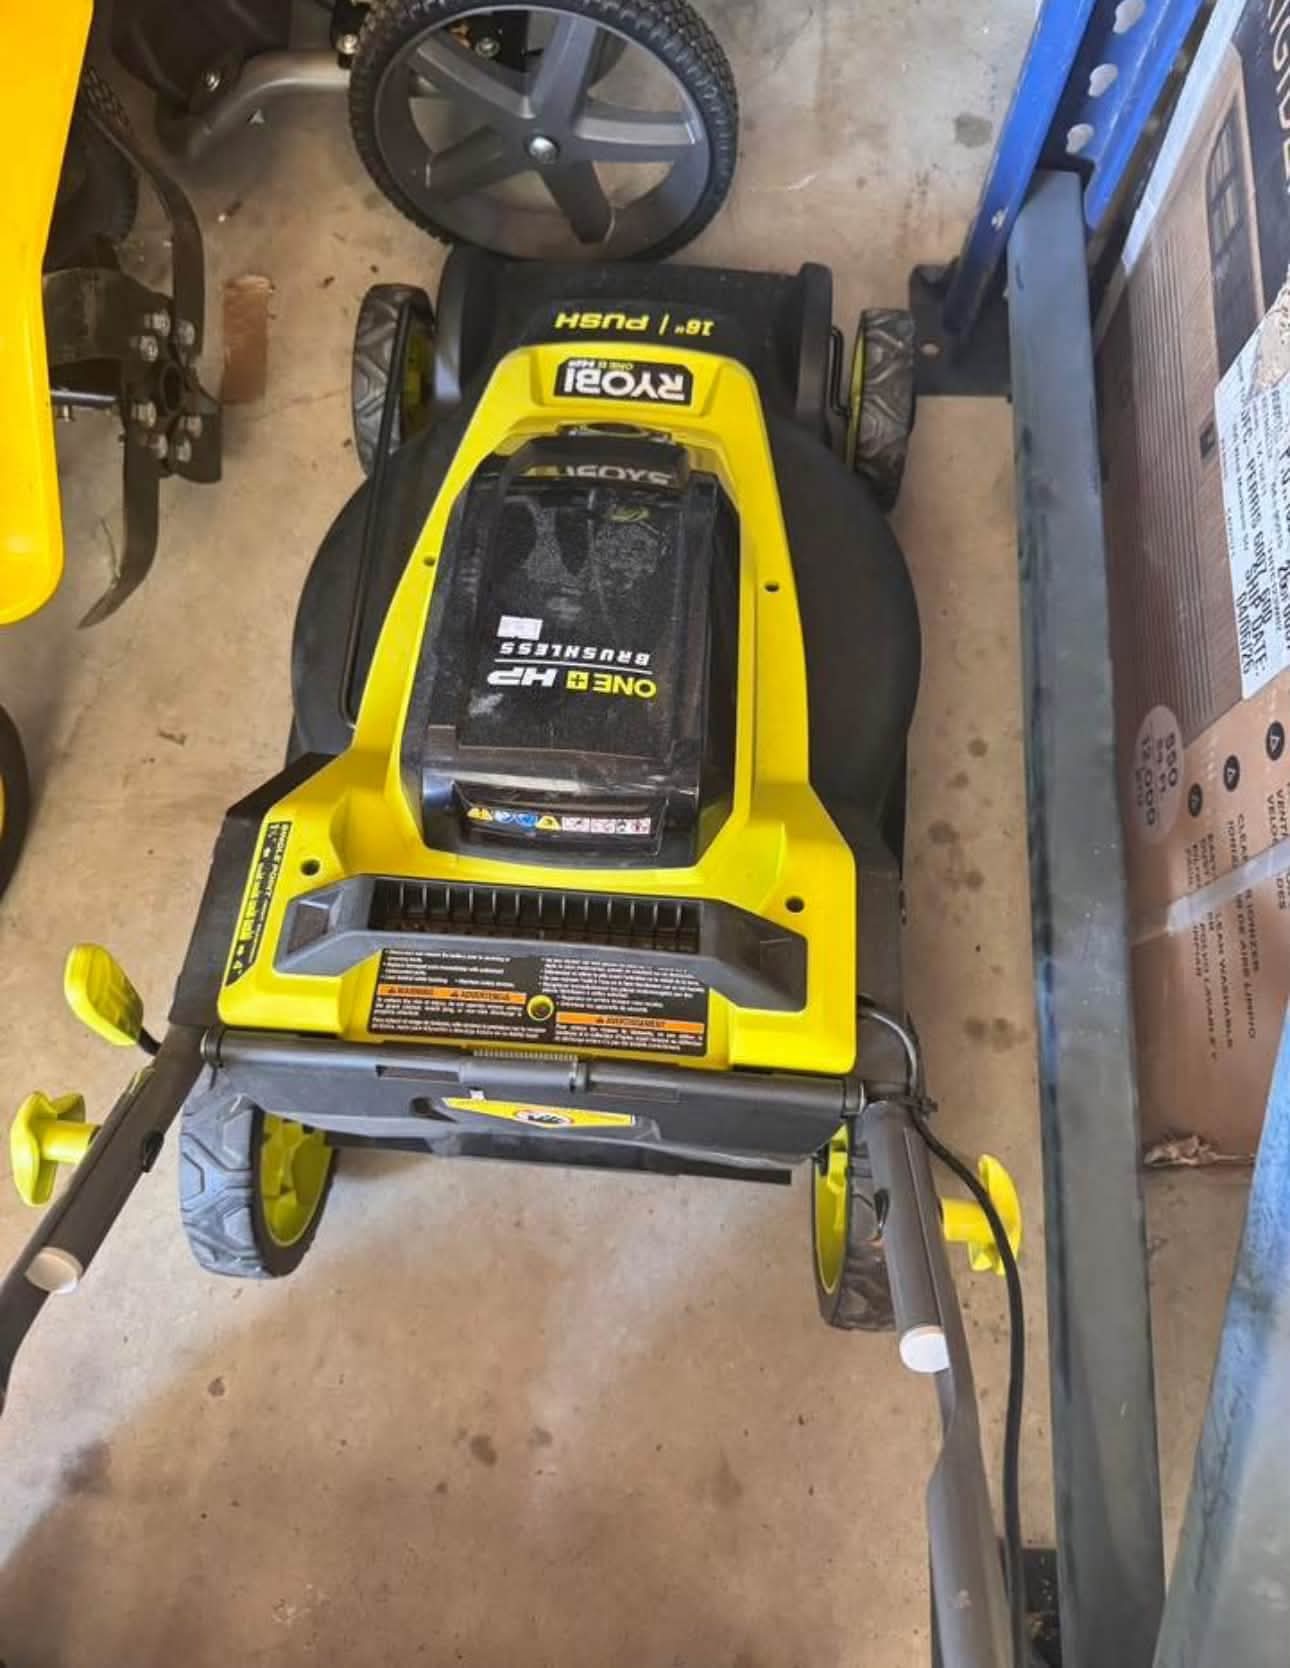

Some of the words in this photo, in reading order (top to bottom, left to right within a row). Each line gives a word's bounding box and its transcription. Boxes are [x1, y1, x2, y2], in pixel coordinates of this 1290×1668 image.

[553, 311, 650, 332] PUSH
[563, 367, 686, 401] RYOBI
[499, 642, 651, 666] BRUSHLESS
[487, 666, 557, 687] HP
